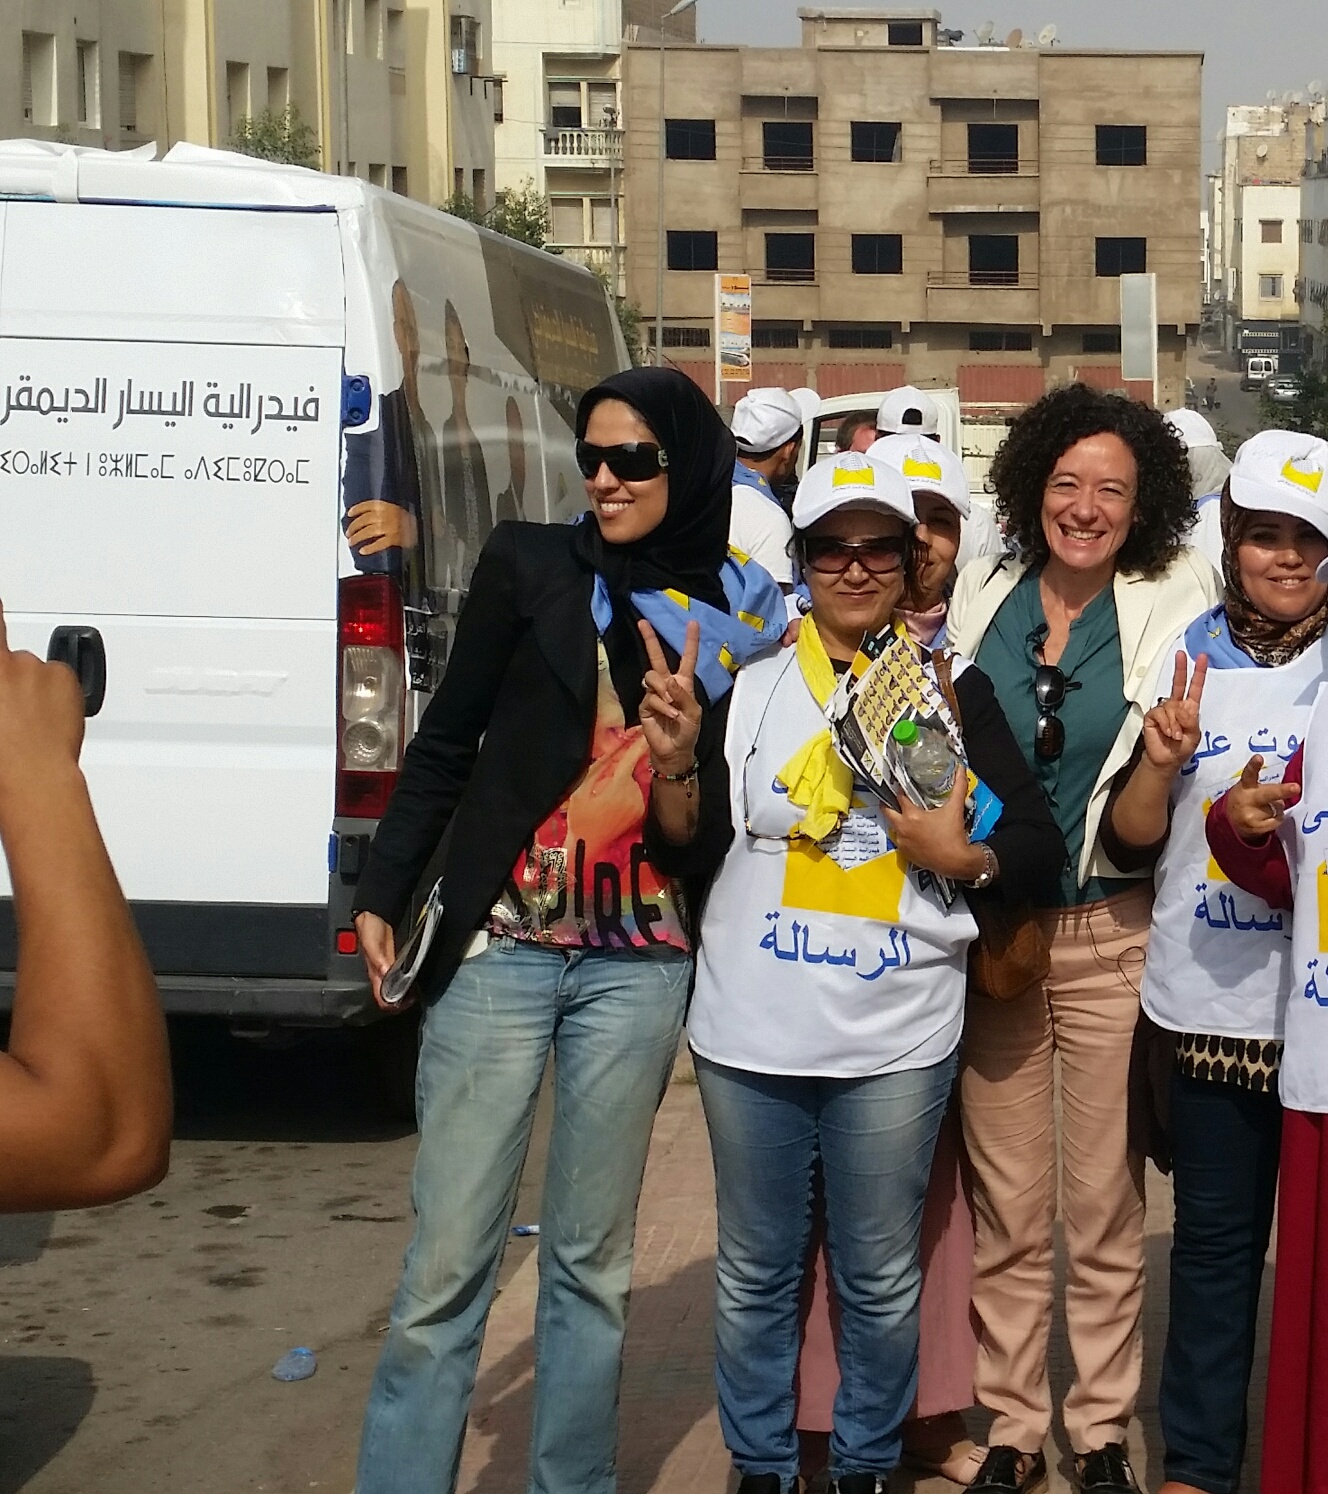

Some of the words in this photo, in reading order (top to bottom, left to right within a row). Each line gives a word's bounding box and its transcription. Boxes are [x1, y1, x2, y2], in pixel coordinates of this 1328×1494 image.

[112, 378, 194, 430] اليسار
[203, 381, 320, 435] فيدرالية
[1180, 730, 1232, 776] على
[1248, 727, 1302, 762] وت
[759, 911, 911, 981] الرسالة
